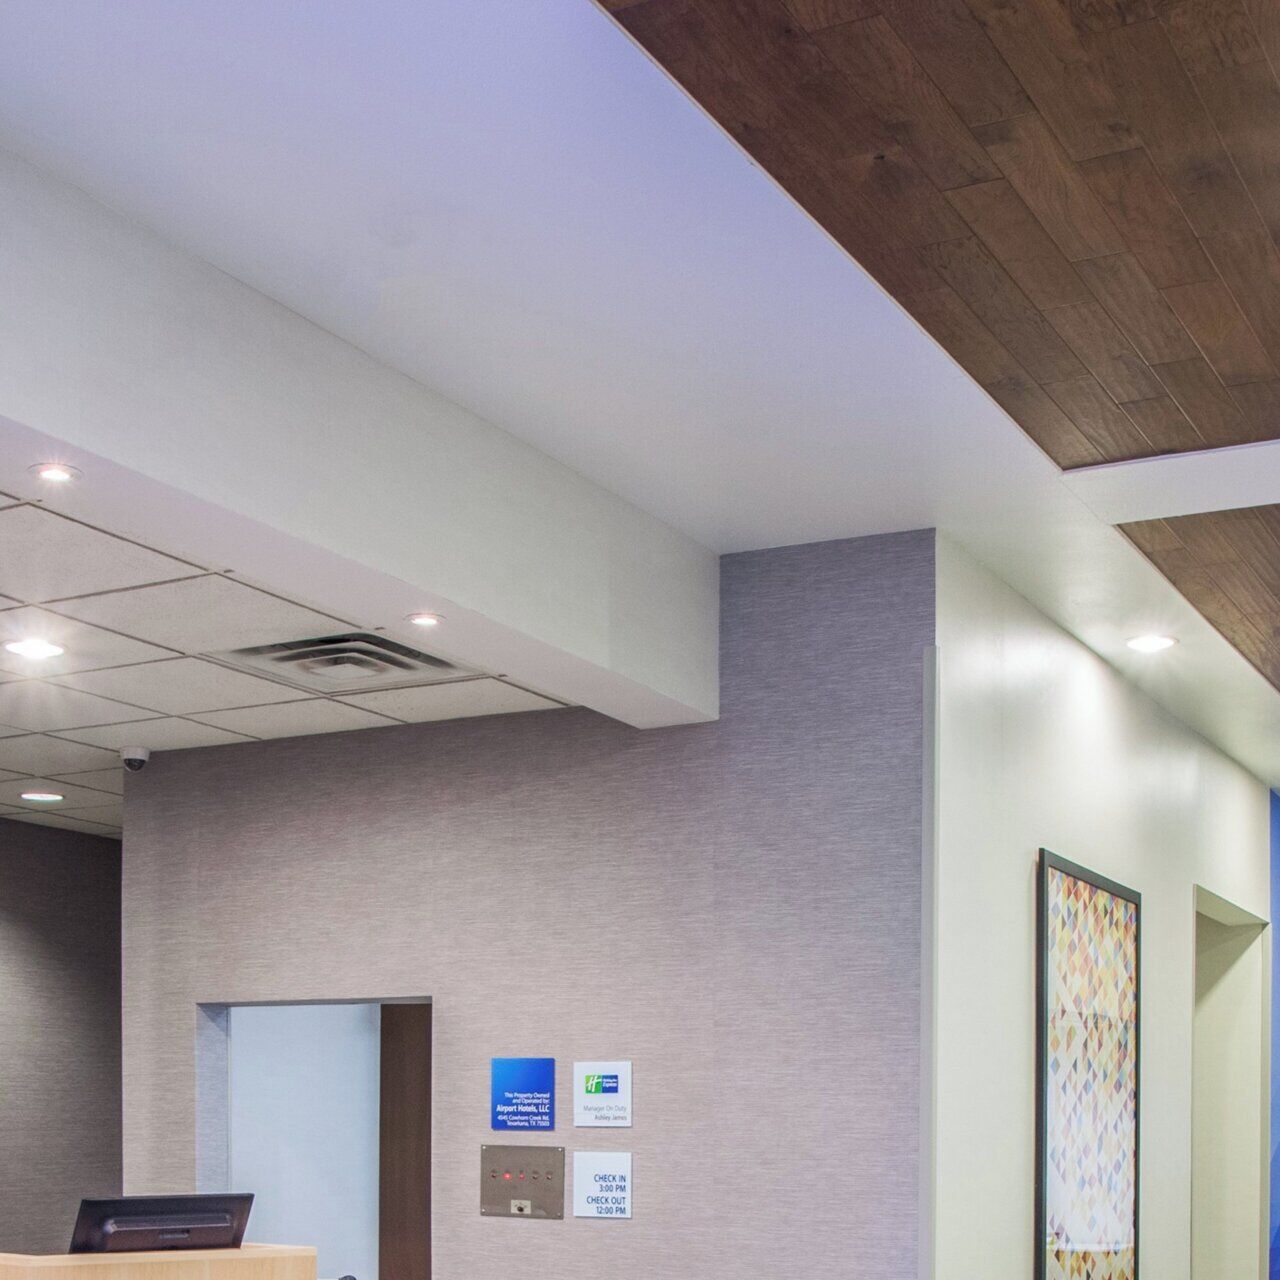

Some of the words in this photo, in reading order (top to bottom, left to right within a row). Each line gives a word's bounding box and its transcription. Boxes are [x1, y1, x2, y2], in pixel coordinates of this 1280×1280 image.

[496, 1104, 517, 1114] Airport
[517, 1104, 538, 1113] Hotels,
[539, 1104, 550, 1112] LLC
[594, 1174, 617, 1182] CHECK
[619, 1174, 626, 1182] IN
[599, 1184, 613, 1192] 3:00
[615, 1184, 626, 1192] PM
[586, 1196, 609, 1204] CHECK
[611, 1196, 626, 1204] OUT
[596, 1206, 613, 1214] 12:00
[615, 1206, 626, 1214] PM
